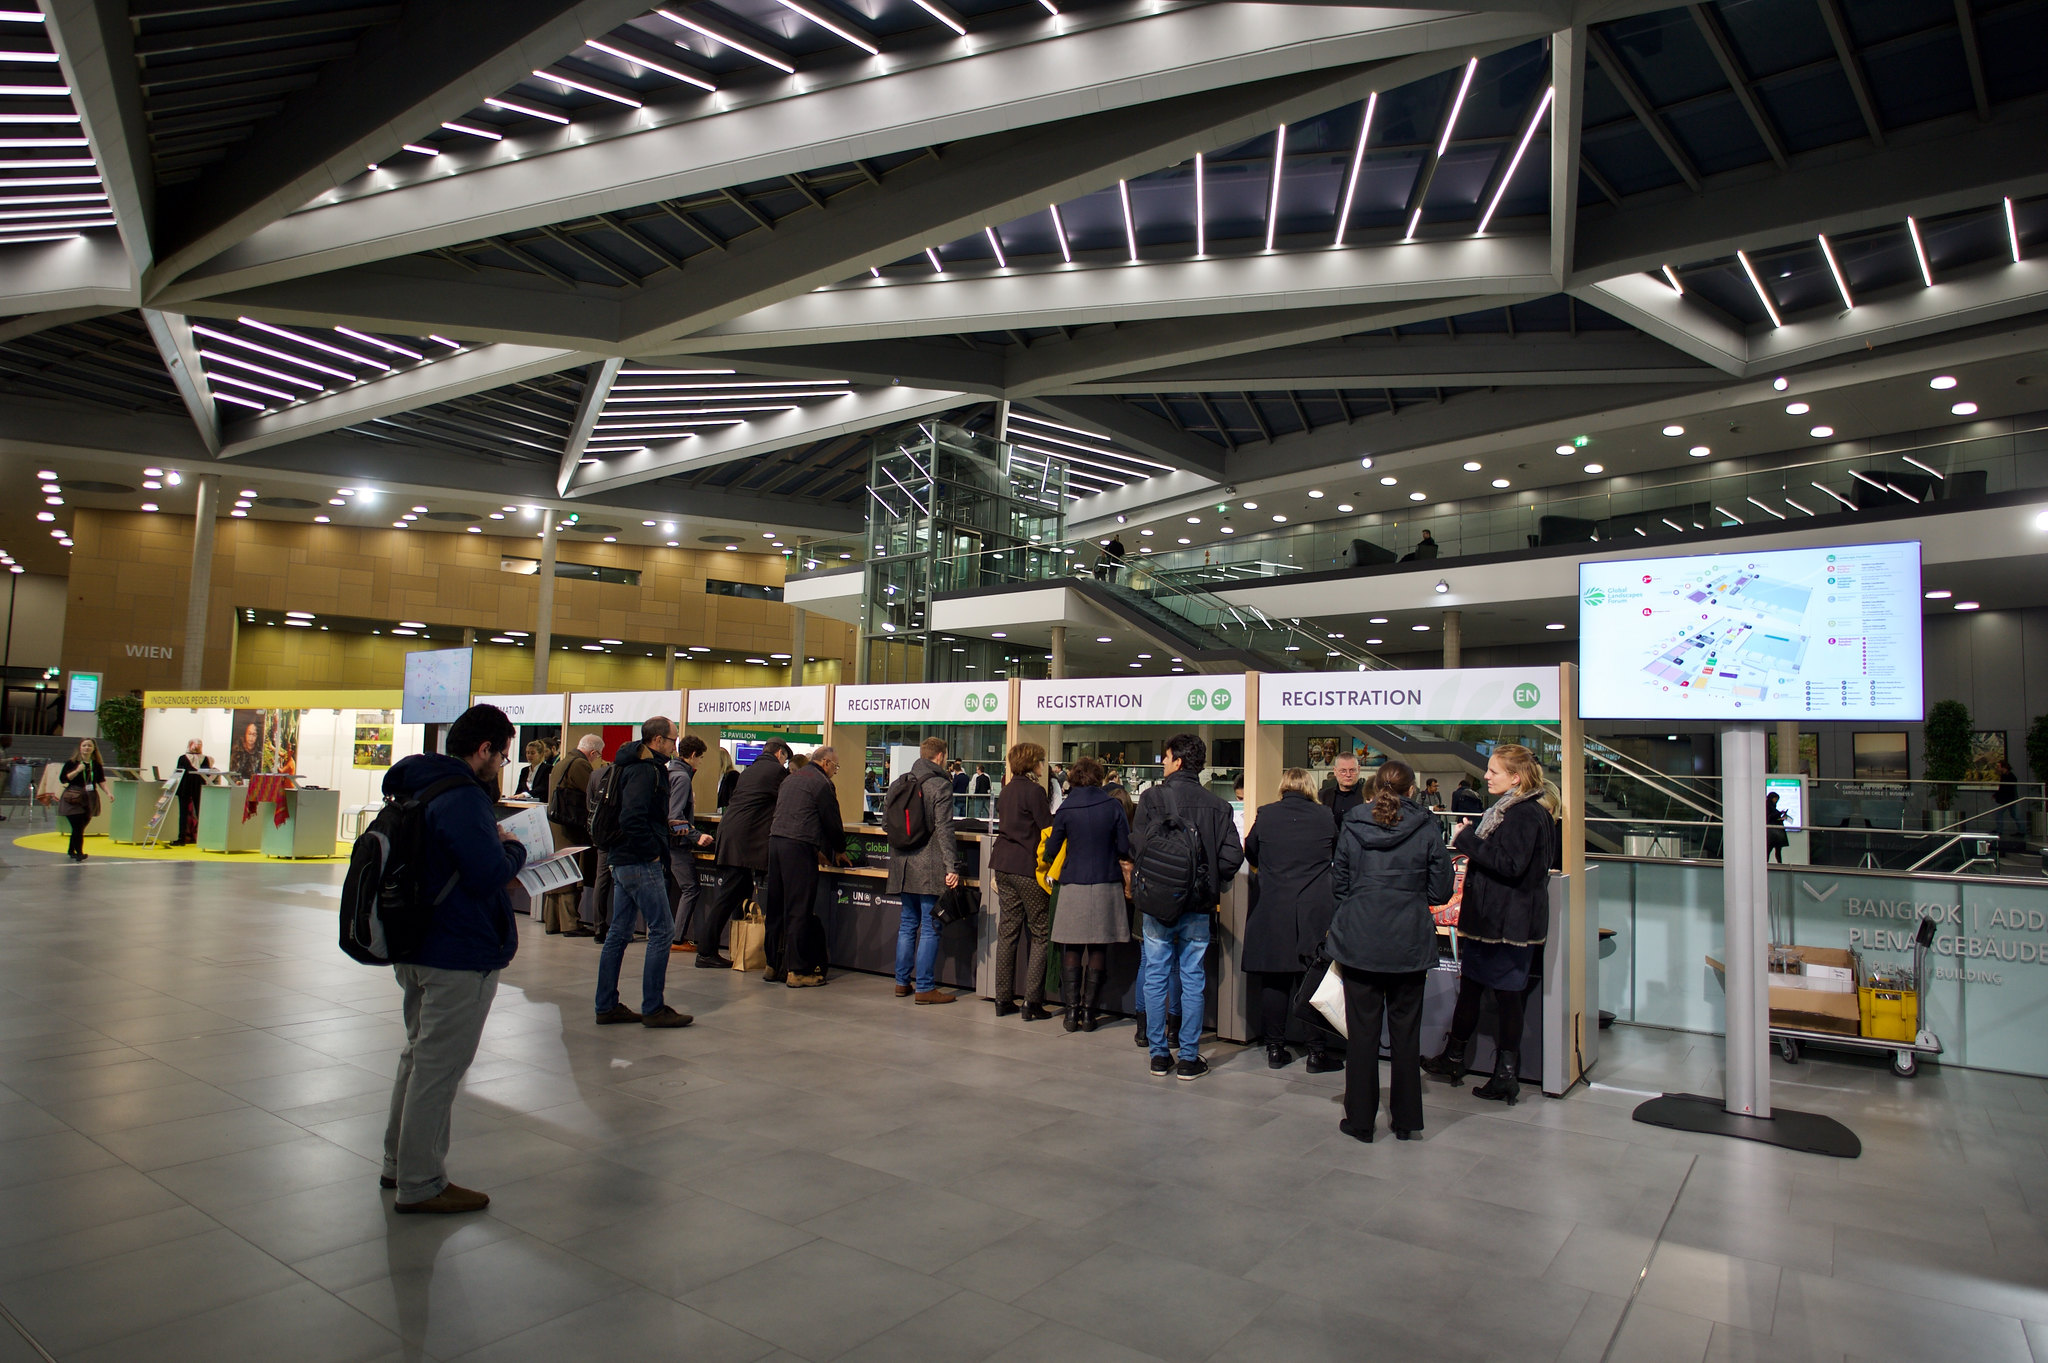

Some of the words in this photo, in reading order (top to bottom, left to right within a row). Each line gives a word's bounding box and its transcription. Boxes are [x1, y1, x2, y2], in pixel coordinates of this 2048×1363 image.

[125, 644, 173, 659] WIEN
[151, 696, 190, 705] INDIGENOUS
[191, 696, 217, 705] PEOPLES
[219, 696, 250, 705] PAVILION
[848, 697, 930, 711] REGISTRATION
[965, 697, 979, 708] EN
[984, 697, 996, 708] FR
[1037, 694, 1142, 709] REGISTRATION
[1190, 694, 1205, 706] EN
[1215, 694, 1228, 705] SP
[1282, 689, 1422, 707] REGISTRATION
[1516, 689, 1538, 702] EN
[500, 705, 525, 715] MATION
[579, 704, 614, 714] SPEAKERS
[698, 701, 751, 713] EXHIBITORS
[760, 700, 791, 712] MEDIA
[728, 731, 757, 739] PAVILION
[866, 842, 889, 853] Global
[853, 891, 864, 901] UN
[1848, 897, 1962, 925] BANGKOK
[1990, 907, 2048, 931] ADD
[1849, 927, 2048, 965] PLENAGEBÄUDE
[1936, 967, 2002, 986] BUILDING
